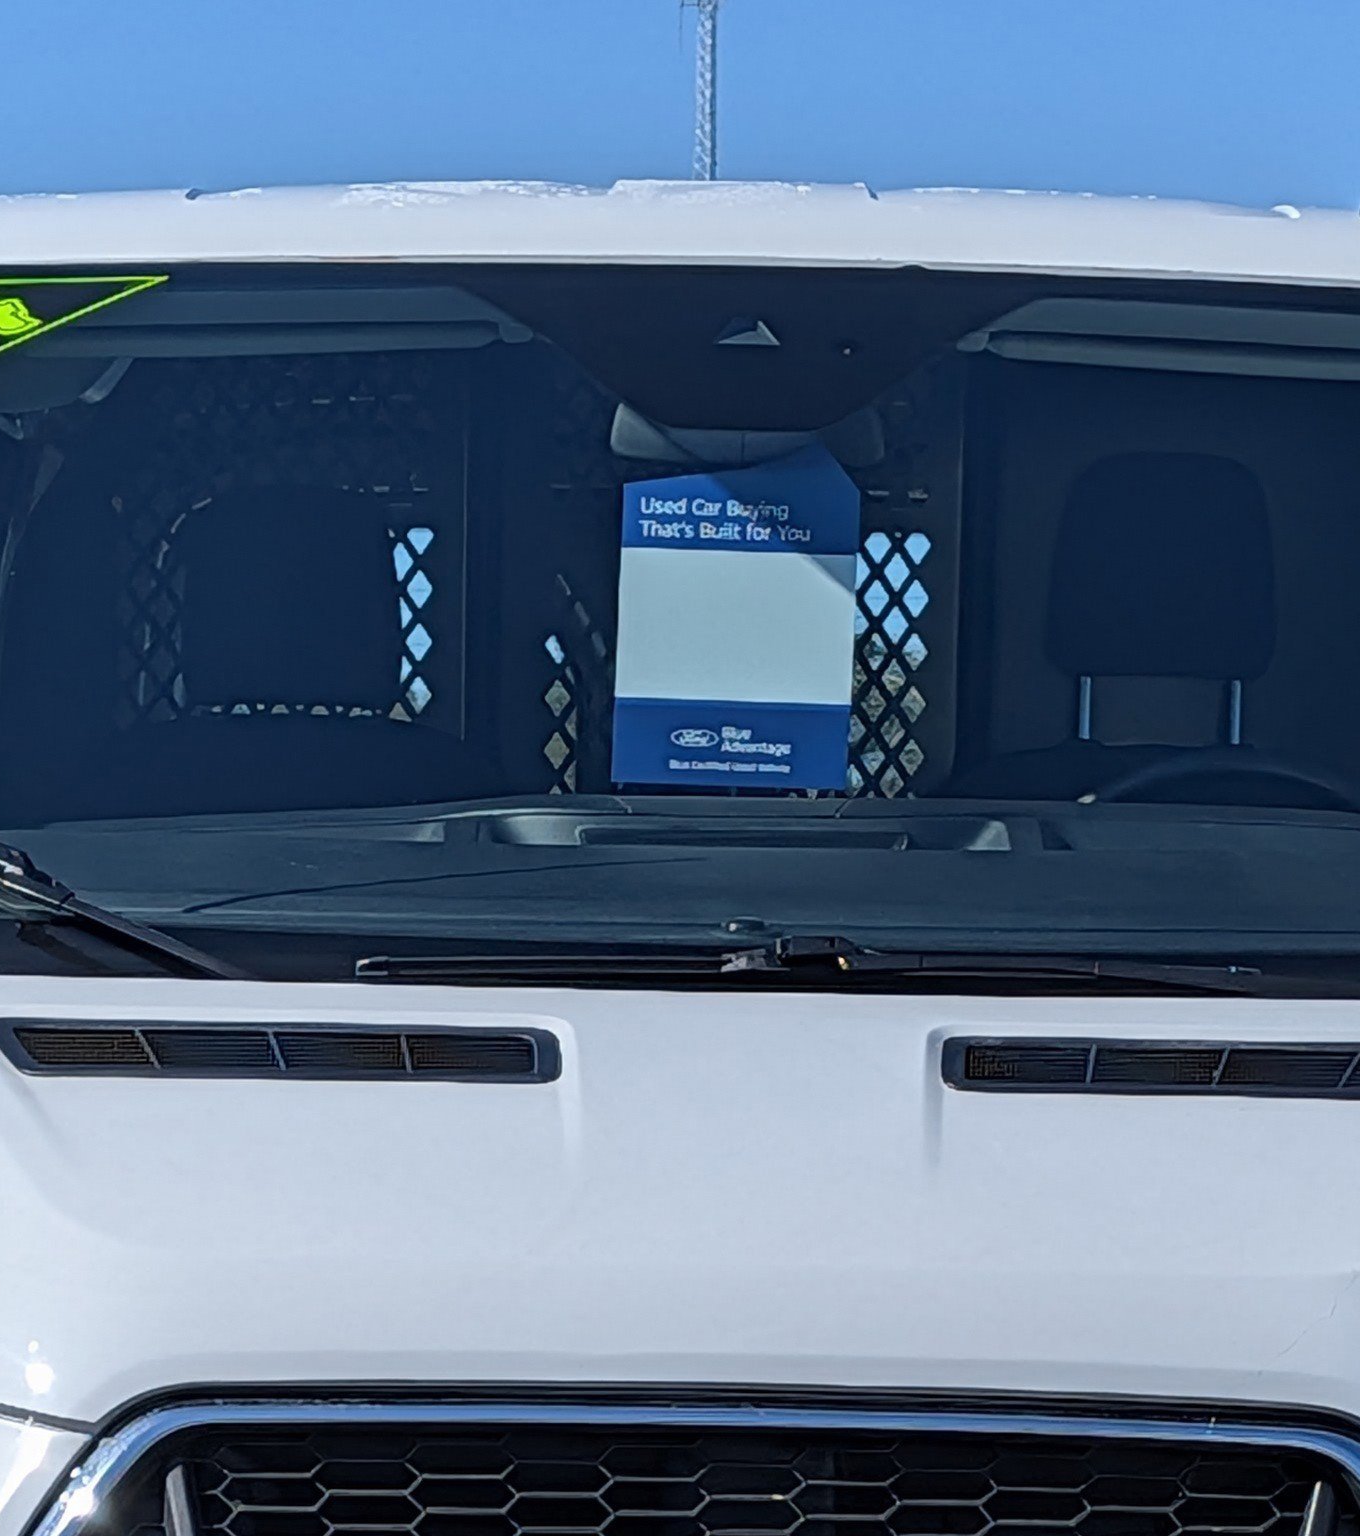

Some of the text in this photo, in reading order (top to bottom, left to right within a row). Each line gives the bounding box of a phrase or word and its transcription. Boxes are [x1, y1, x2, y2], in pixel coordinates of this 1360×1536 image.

[640, 496, 790, 521] Used Car Buying
[638, 519, 811, 542] That's Built for You
